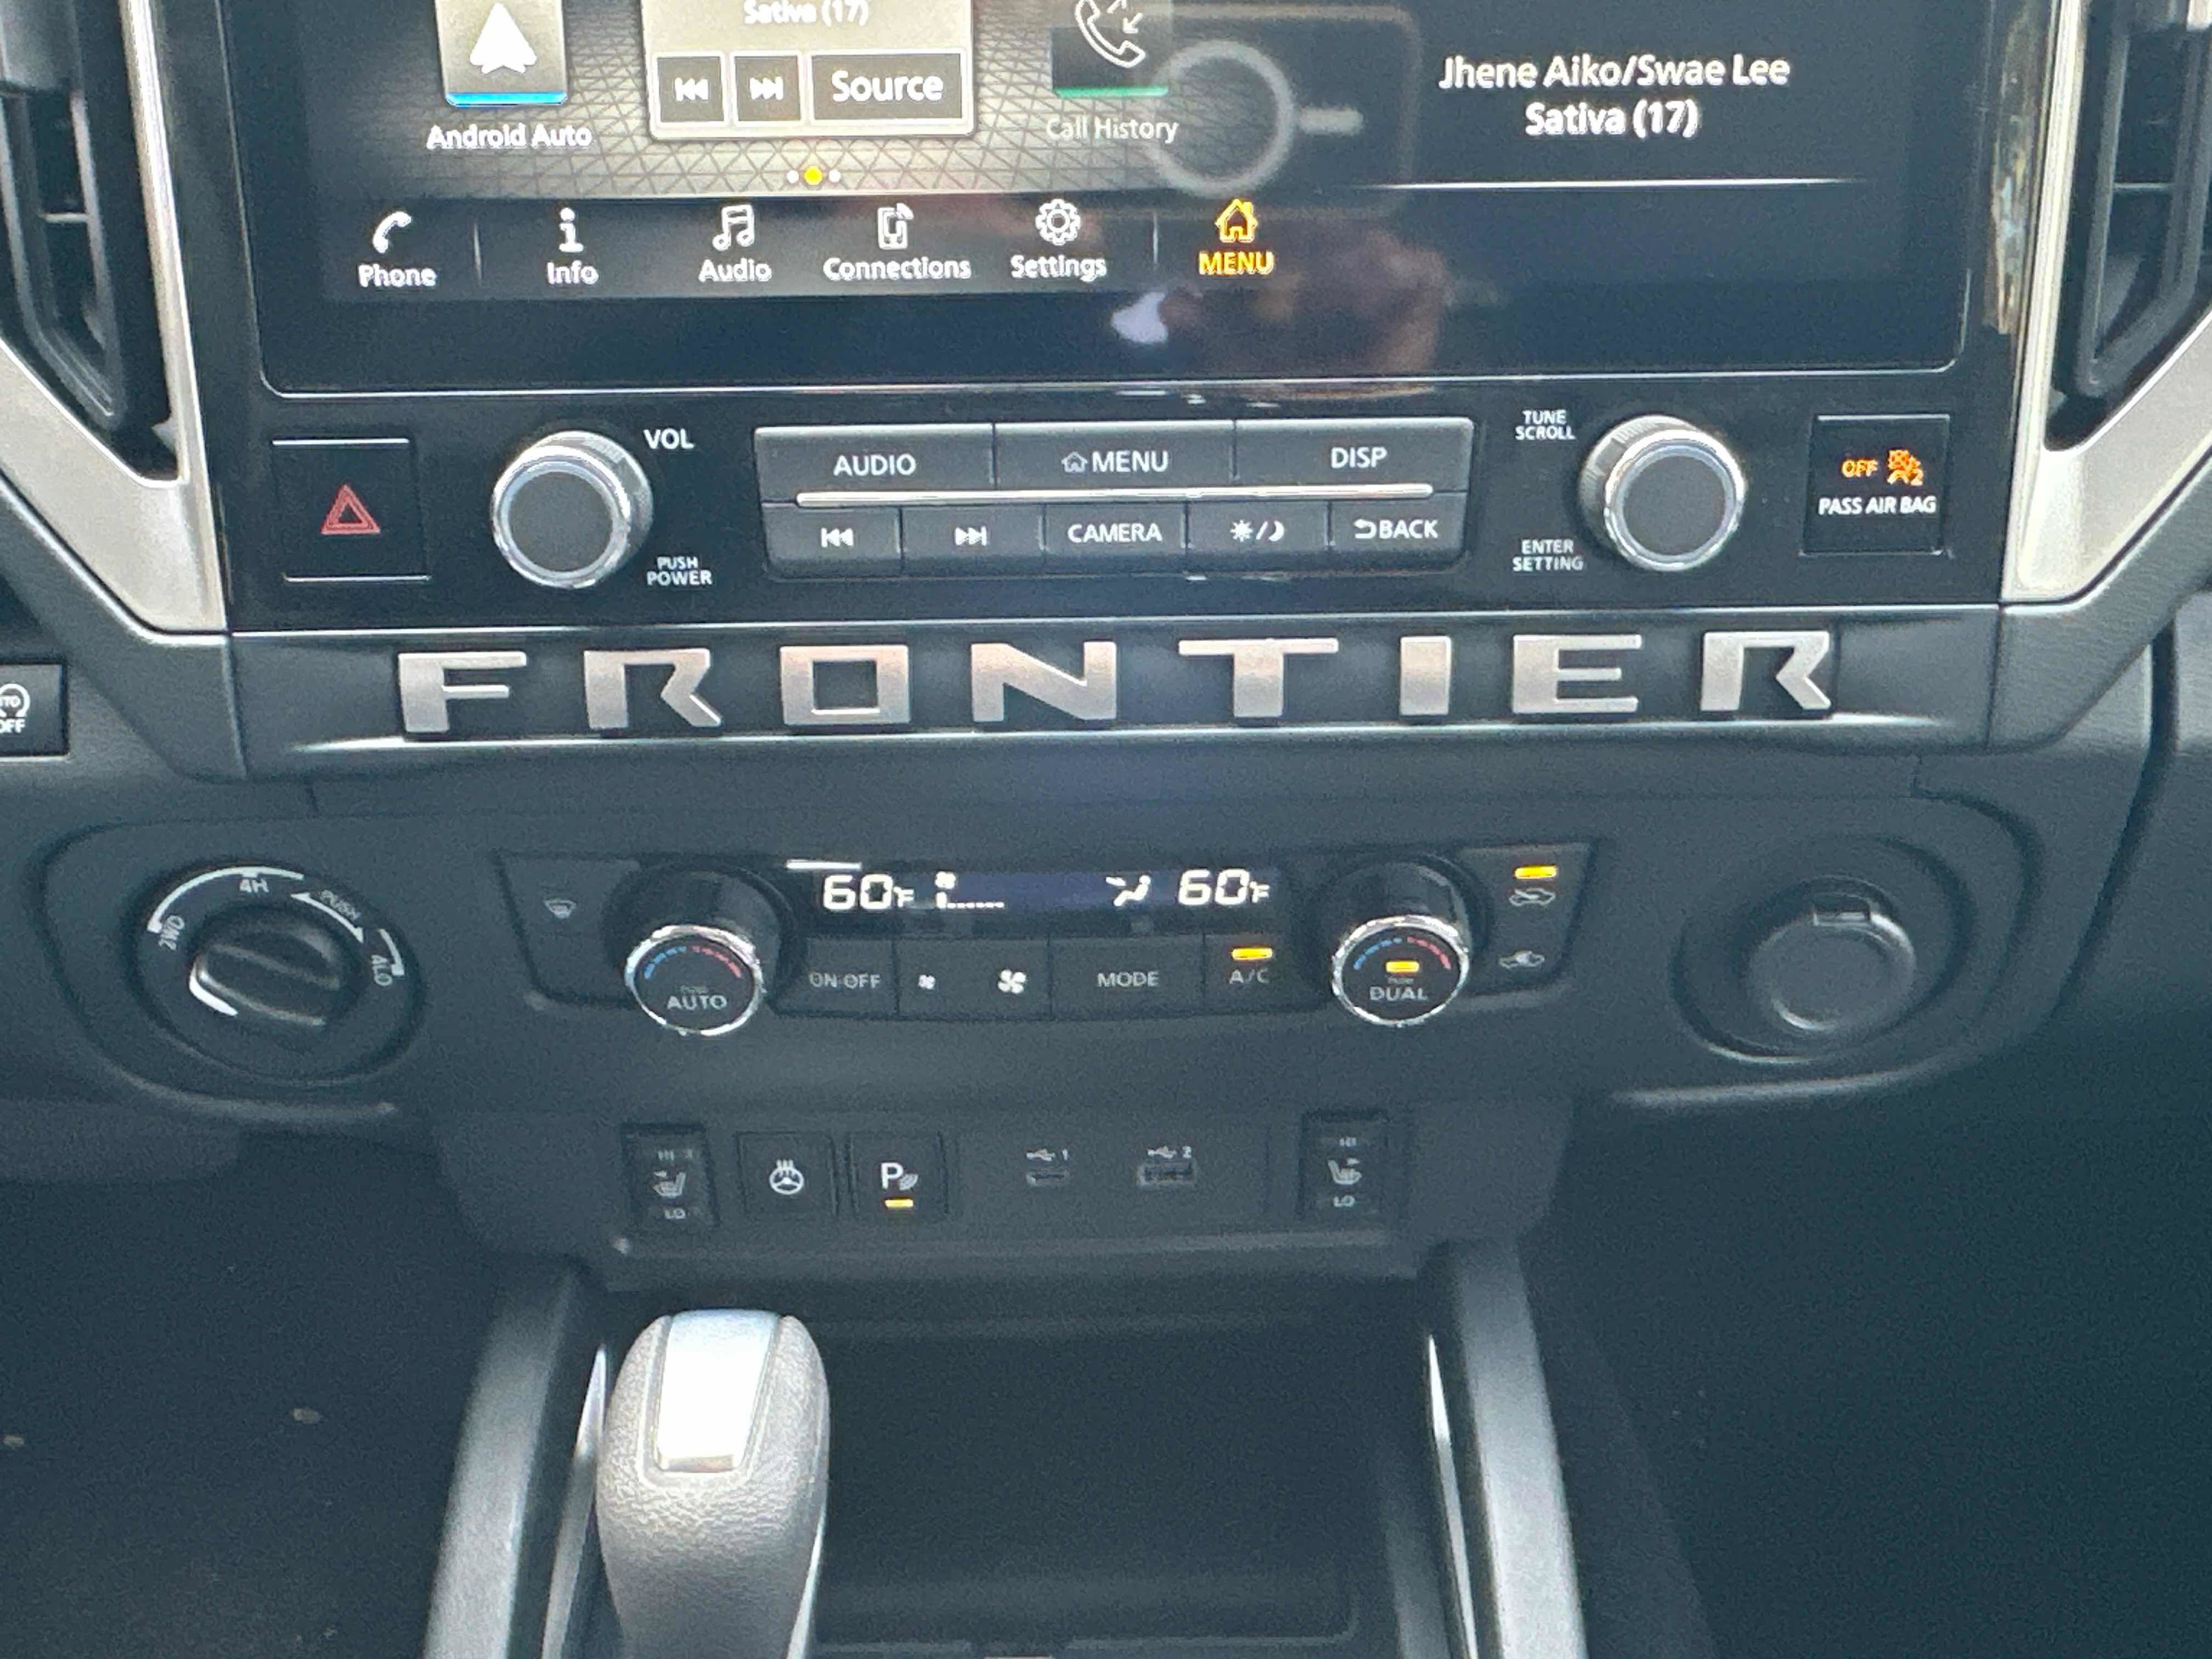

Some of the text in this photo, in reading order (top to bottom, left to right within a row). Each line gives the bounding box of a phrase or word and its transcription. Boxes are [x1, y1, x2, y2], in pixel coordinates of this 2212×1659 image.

[743, 0, 869, 26] Sativa (17)
[1438, 53, 1791, 89] Jhene Aiko/Swae Lee
[831, 70, 944, 103] Source
[1525, 98, 1700, 138] Sativa (17)
[426, 122, 594, 150] Android Auto
[1046, 117, 1180, 144] Call History
[546, 260, 600, 286] Info
[698, 258, 772, 283] Audio
[823, 257, 972, 281] Connections
[1011, 255, 1108, 283] Settings
[1199, 251, 1275, 275] MENU
[357, 263, 437, 288] Phone
[1522, 409, 1567, 426] TUNE
[644, 428, 695, 450] VOL
[1515, 425, 1576, 441] SCROLL
[833, 453, 916, 477] AUDIO
[1091, 450, 1169, 473] MENU
[1330, 447, 1387, 469] DISP
[1841, 459, 1878, 478] OFF
[1818, 495, 1937, 516] PASS AIR BAG
[1067, 523, 1163, 543] CAMERA
[1378, 519, 1439, 539] BACK
[1521, 539, 1575, 555] ENTER
[657, 556, 699, 571] PUSH
[1512, 556, 1584, 572] SETTING
[646, 569, 713, 587] POWER
[398, 630, 1835, 735] FRONTIER
[239, 879, 269, 893] 4H
[158, 915, 185, 951] 2WD
[371, 954, 393, 987] 4LO
[1097, 970, 1159, 988] MODE
[1229, 968, 1269, 984] A/C
[667, 994, 728, 1011] AUTO
[1369, 986, 1430, 1002] DUAL
